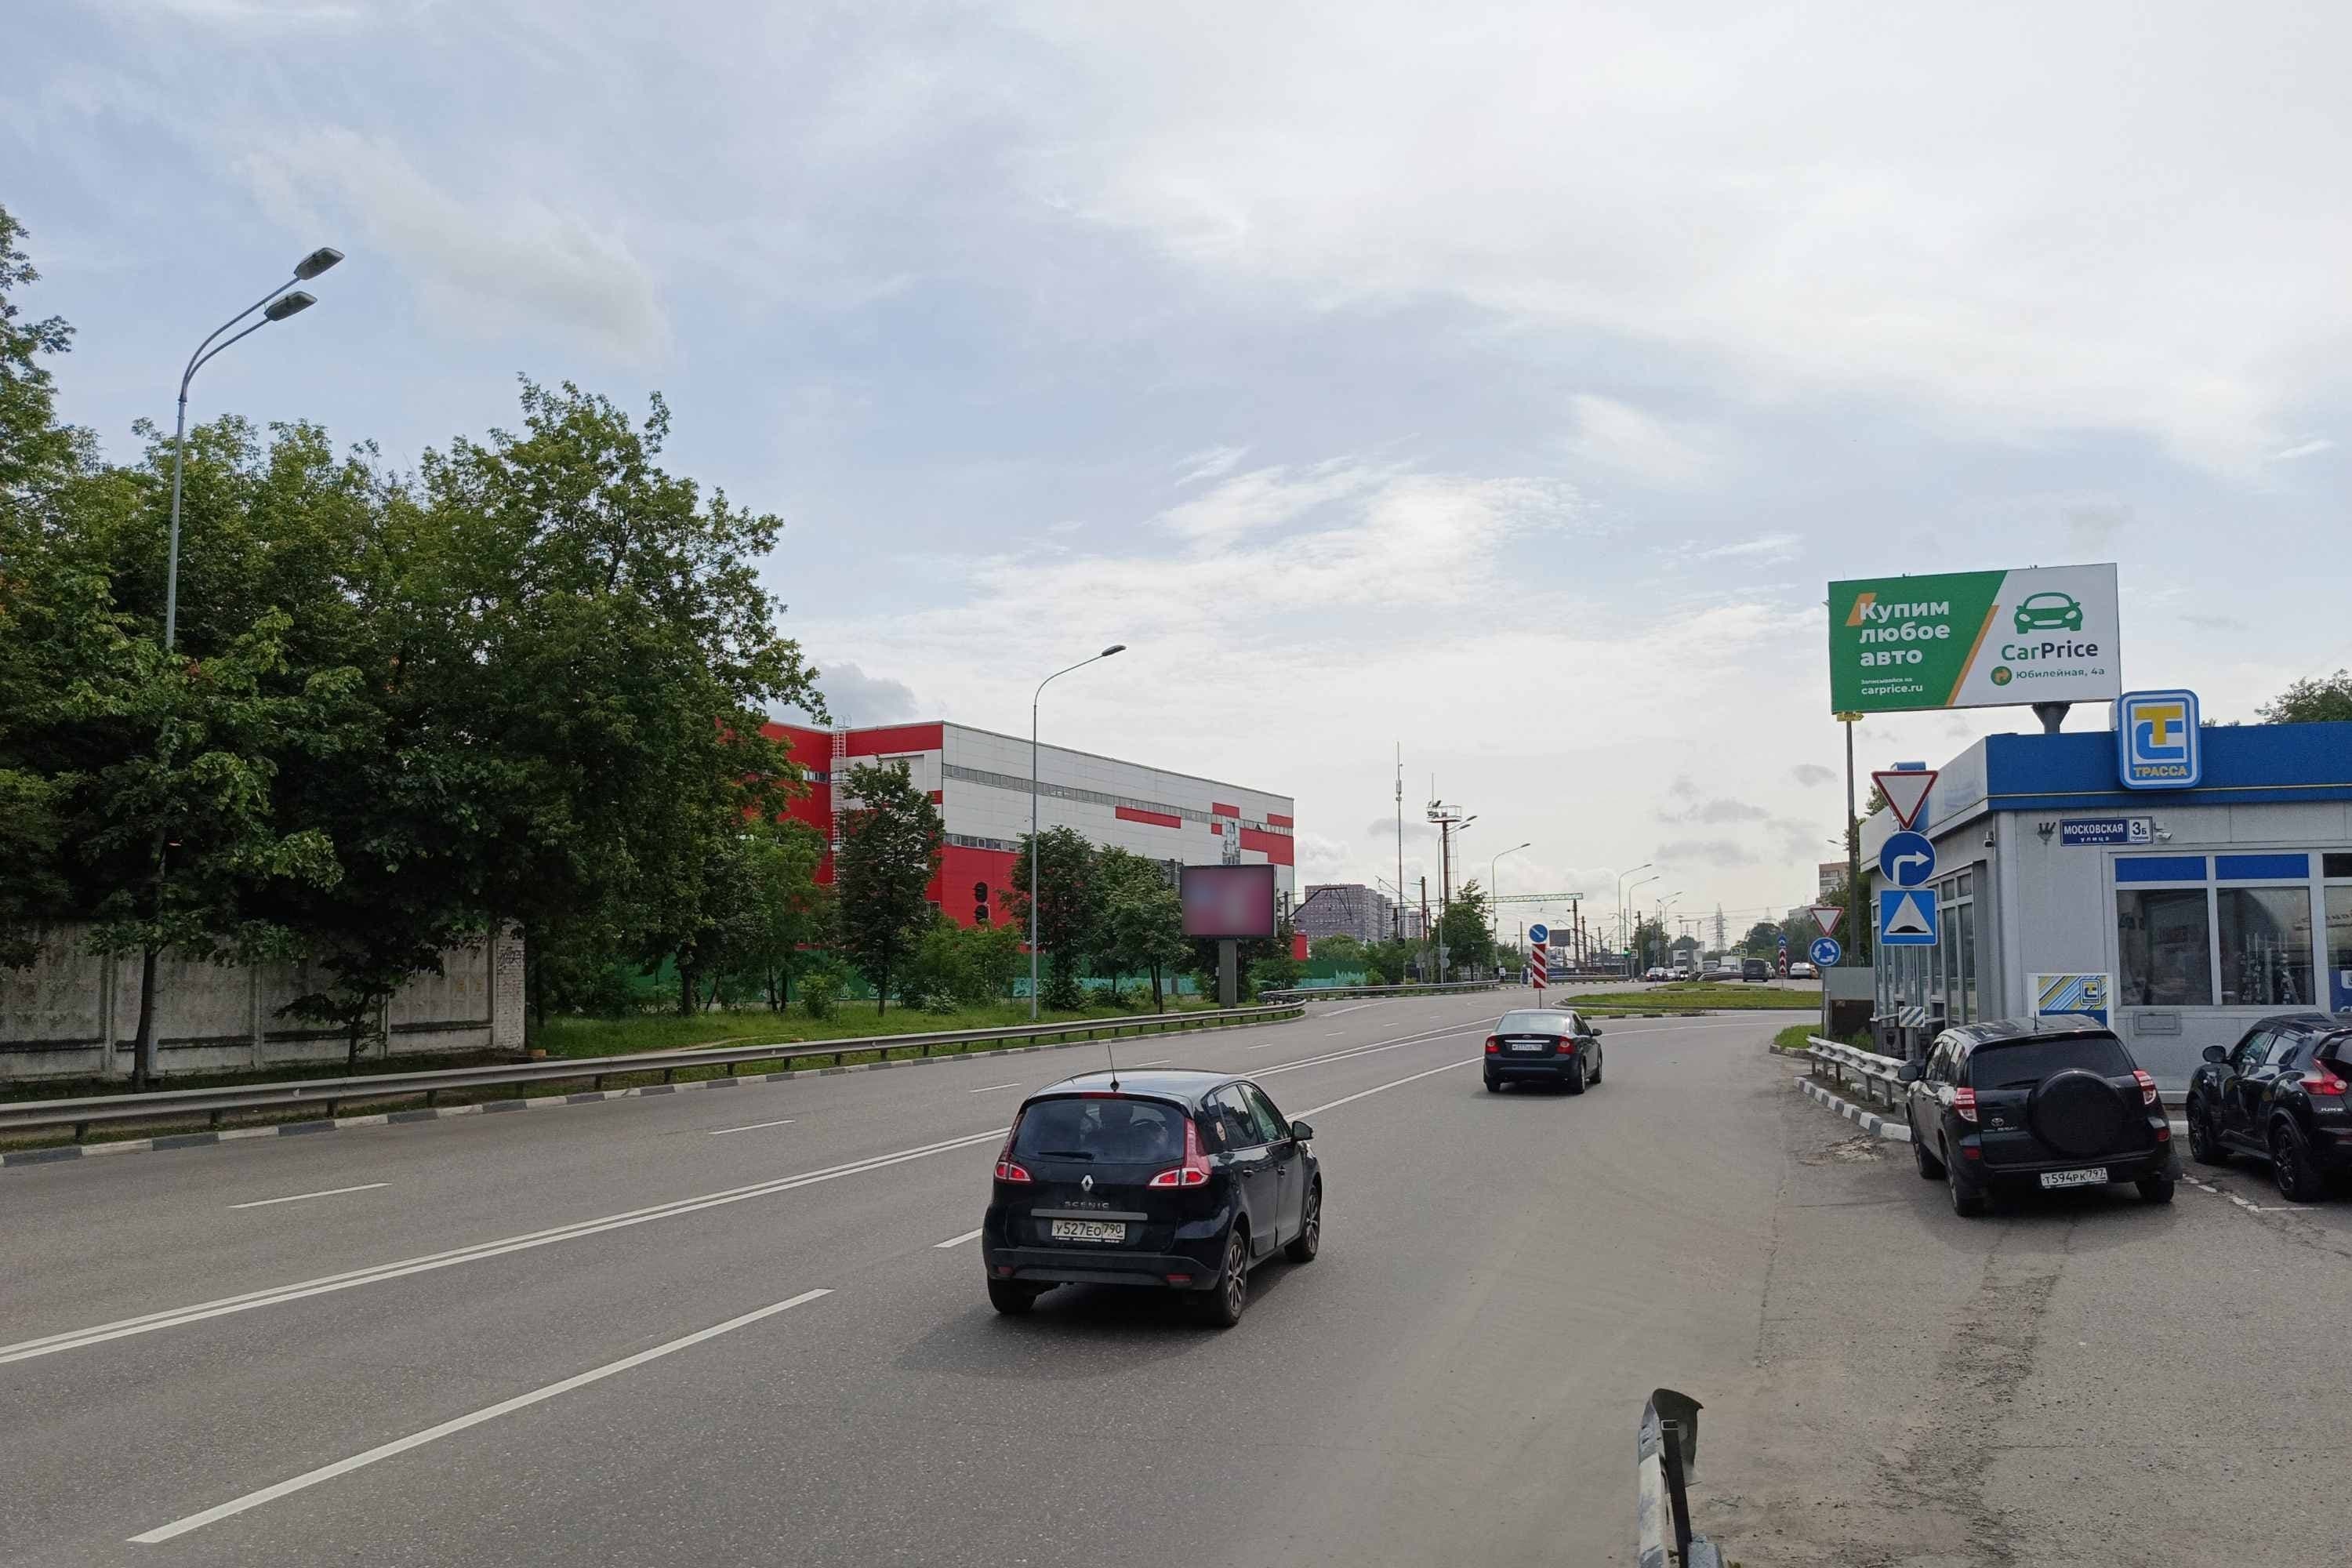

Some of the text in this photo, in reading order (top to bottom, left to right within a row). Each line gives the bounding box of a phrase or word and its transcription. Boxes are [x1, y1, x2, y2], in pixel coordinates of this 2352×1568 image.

[1860, 601, 1950, 624] Купим
[1859, 621, 1951, 644] любое
[1860, 649, 1923, 666] авто
[2001, 640, 2099, 661] CarPrice
[2016, 669, 2089, 679] Юбилейная,
[1860, 684, 1923, 695] carprice.ru
[2132, 765, 2188, 778] ТРАССА
[2063, 823, 2124, 835] МОСКОВСКАЯ
